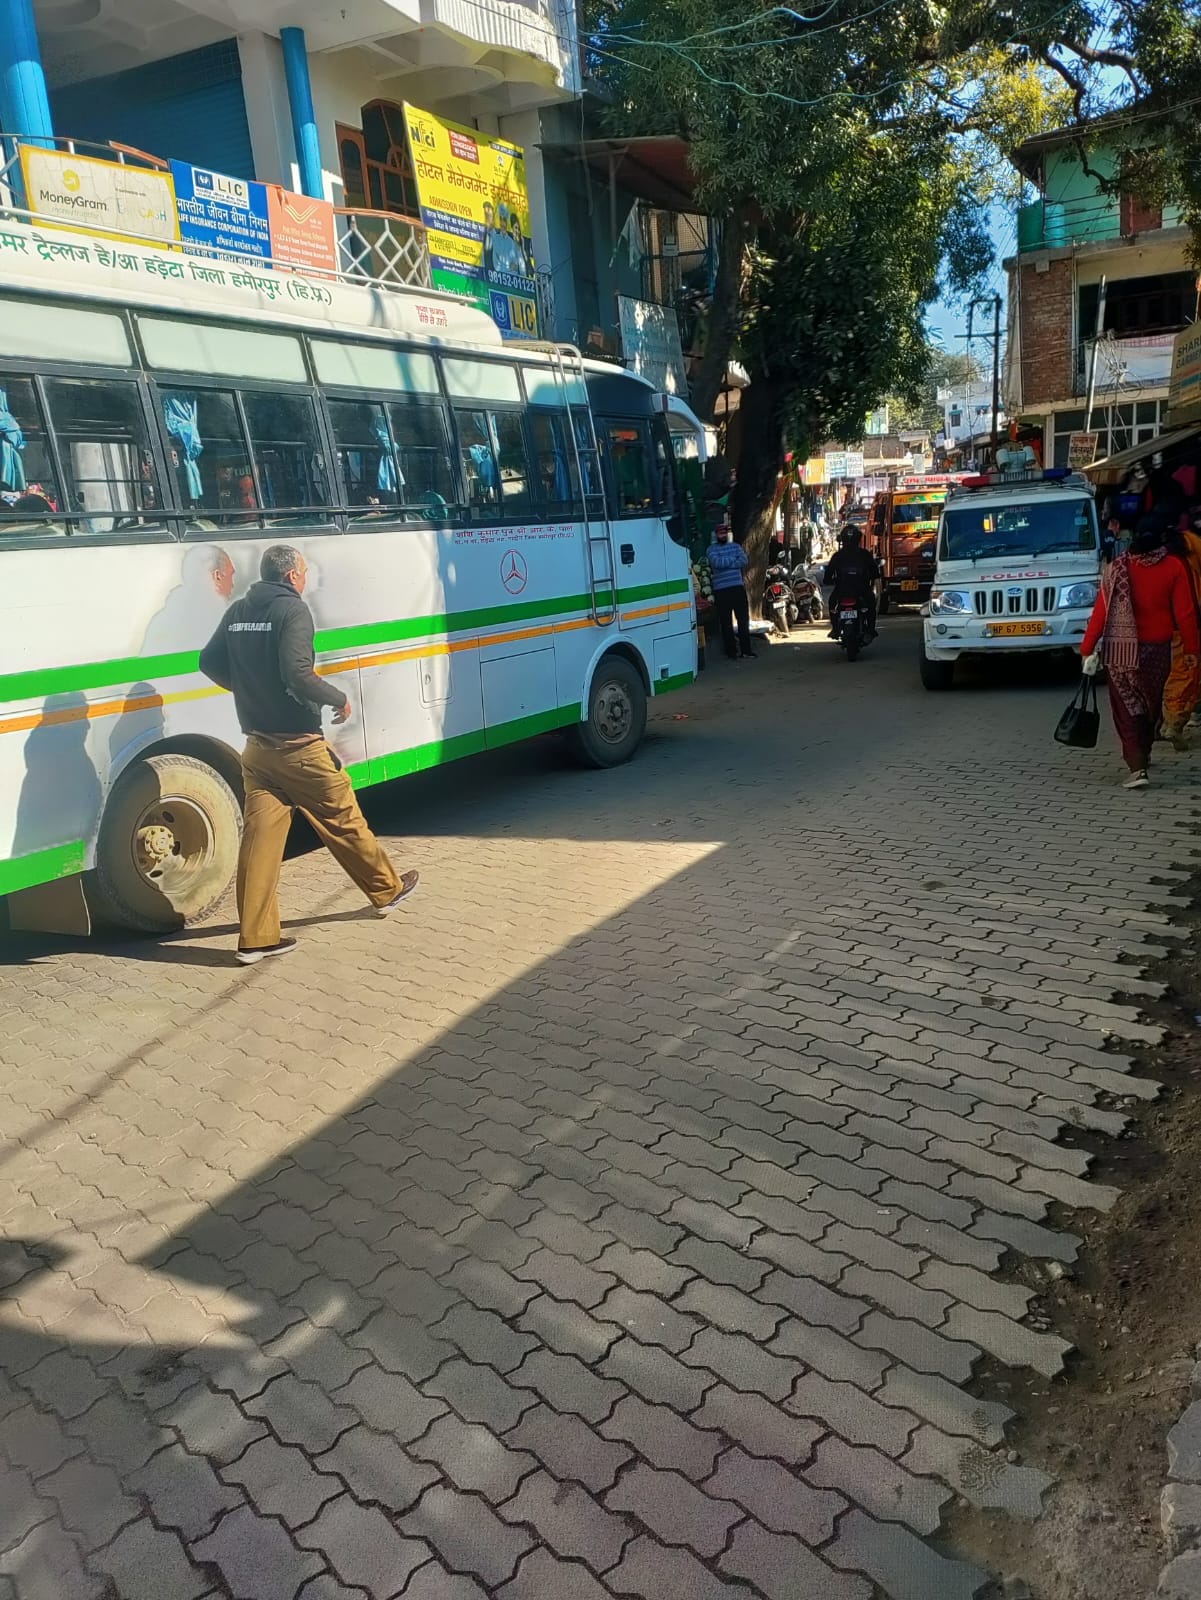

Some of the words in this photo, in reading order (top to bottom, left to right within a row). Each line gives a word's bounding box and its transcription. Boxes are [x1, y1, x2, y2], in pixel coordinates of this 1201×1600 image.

[415, 153, 445, 181] होटल
[217, 178, 243, 196] LIC
[40, 190, 107, 211] MoneyGram
[207, 201, 229, 222] जीवन
[230, 207, 247, 226] बीमा
[248, 211, 268, 231] निगम
[0, 232, 29, 255] मर
[188, 260, 227, 286] जिला
[228, 269, 283, 300] हमीरपुर
[488, 270, 536, 293] 98152-01122
[511, 300, 534, 331] LIC
[980, 570, 1050, 581] POLICE
[993, 625, 1004, 633] HP
[1006, 625, 1017, 633] 67
[1020, 622, 1042, 633] 5956
